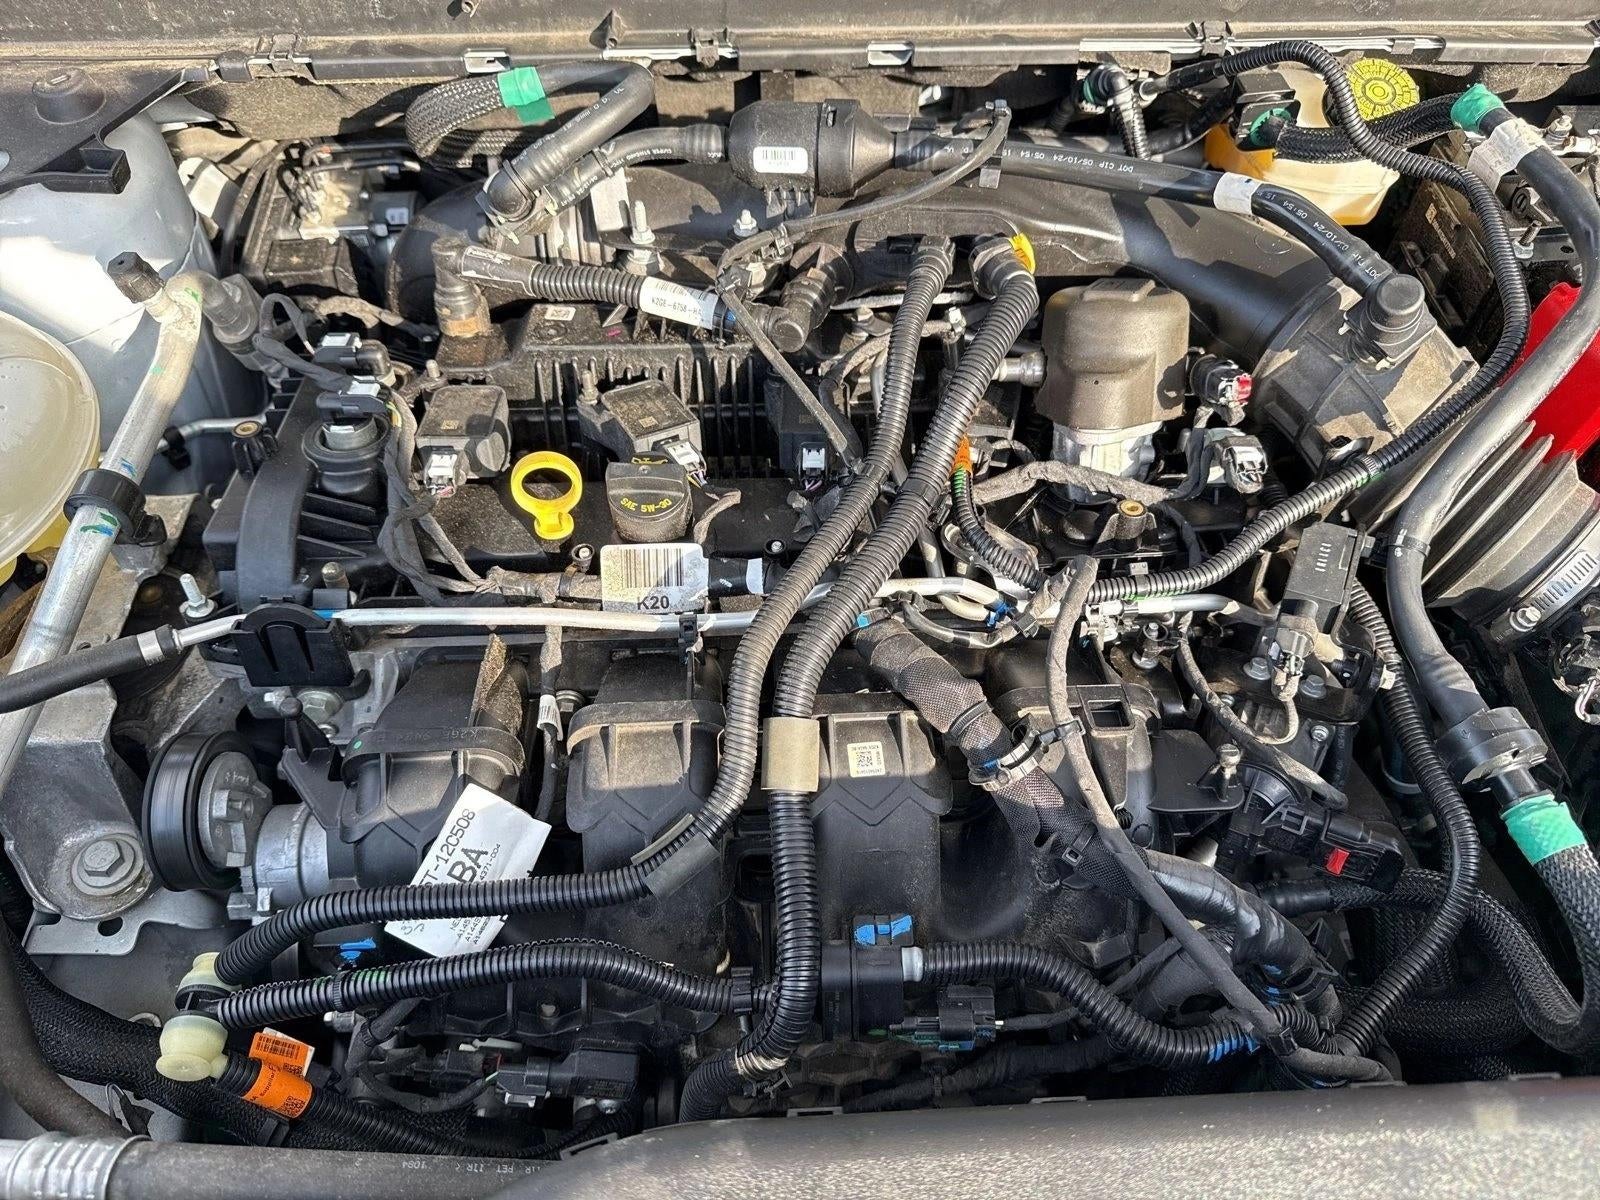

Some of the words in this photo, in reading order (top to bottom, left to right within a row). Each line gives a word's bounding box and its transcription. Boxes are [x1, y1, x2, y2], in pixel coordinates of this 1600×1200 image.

[1020, 150, 1045, 160] 05:54
[1052, 153, 1094, 166] 05/10/24
[1098, 161, 1115, 170] CIP
[1117, 163, 1134, 173] DOT
[1282, 200, 1308, 219] 05:54
[620, 497, 638, 511] SAE
[640, 498, 673, 512] 5W-30
[637, 595, 670, 610] K20
[446, 847, 489, 884] BA
[495, 1164, 514, 1174] PET
